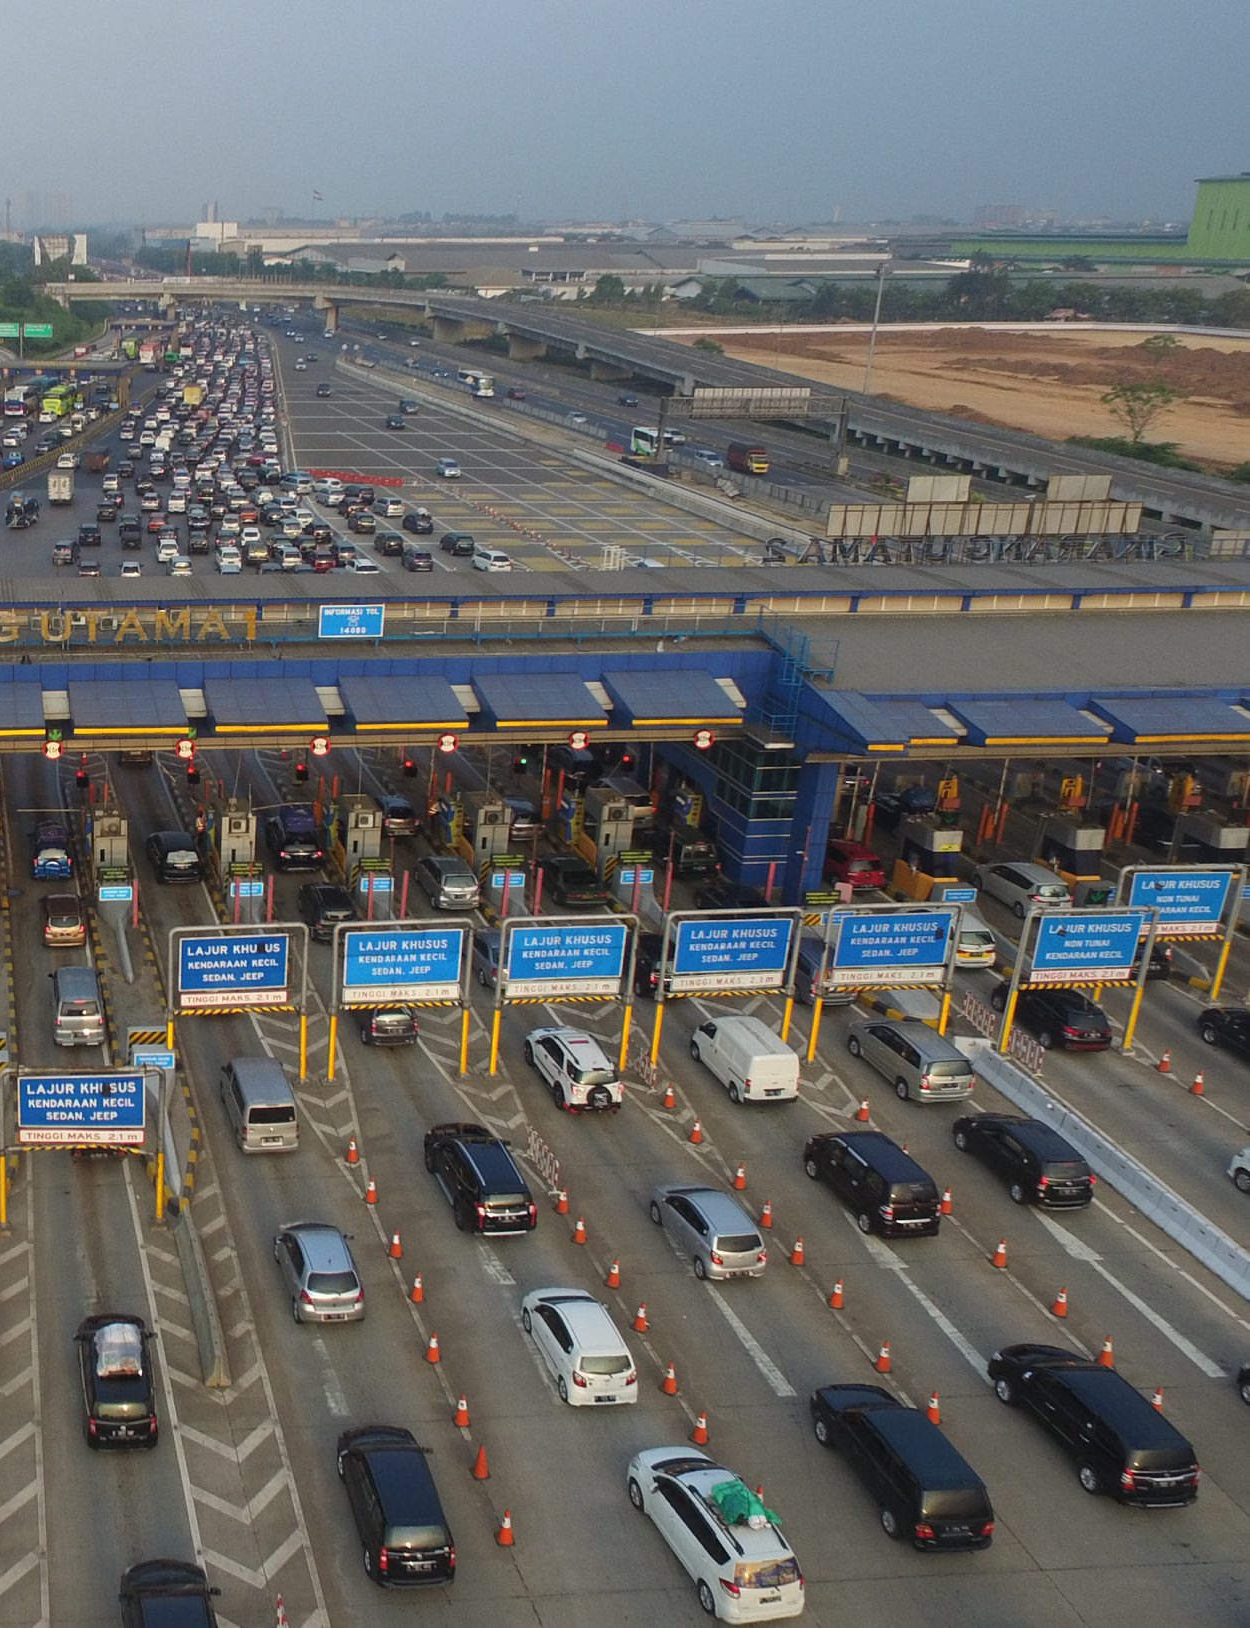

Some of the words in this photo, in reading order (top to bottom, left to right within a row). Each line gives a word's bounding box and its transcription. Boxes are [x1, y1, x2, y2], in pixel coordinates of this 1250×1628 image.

[324, 608, 363, 616] INFORMASI
[41, 608, 231, 642] UTAMA
[1178, 880, 1220, 889] KHUSUS
[1156, 895, 1174, 903] NON
[853, 923, 890, 933] LAJUR
[893, 922, 938, 932] KHUSUS
[1087, 923, 1132, 933] KHUSUS
[691, 930, 728, 939] LAJUR
[732, 928, 778, 938] KHUSUS
[359, 941, 397, 951] LAJUR
[402, 939, 448, 950] KHUSUS
[524, 936, 561, 946] LAJUR
[565, 935, 611, 945] KHUSUS
[851, 936, 907, 945] KENDARAAN
[1064, 940, 1083, 948] NON
[1085, 939, 1110, 947] TUNAI
[187, 945, 228, 956] LAJUR
[233, 943, 280, 954] KHUUS
[689, 942, 746, 951] KENDARAAN
[750, 941, 776, 949] KECIL
[522, 949, 580, 959] KENDARAAN
[583, 948, 610, 956] KECIL
[897, 948, 918, 956] JEEP
[1045, 951, 1098, 960] KENDARAAN
[420, 953, 447, 961] KECIL
[736, 953, 758, 961] JEEP
[188, 960, 247, 969] KENDARAAN
[252, 959, 278, 967] KECIL
[571, 960, 593, 968] JEEP
[409, 966, 431, 974] JEEP
[240, 972, 264, 980] JEEP
[1035, 972, 1067, 980] TINGGI
[680, 978, 711, 987] TINGGI
[514, 985, 547, 993] TINGGI
[352, 990, 386, 998] TINGGI
[27, 1083, 74, 1094] LAJUR
[80, 1082, 136, 1094] KHSUS
[28, 1098, 97, 1108] KENDARAAN
[102, 1098, 135, 1107] KECIL
[90, 1111, 118, 1120] JEEP
[27, 1132, 62, 1140] TINGGI
